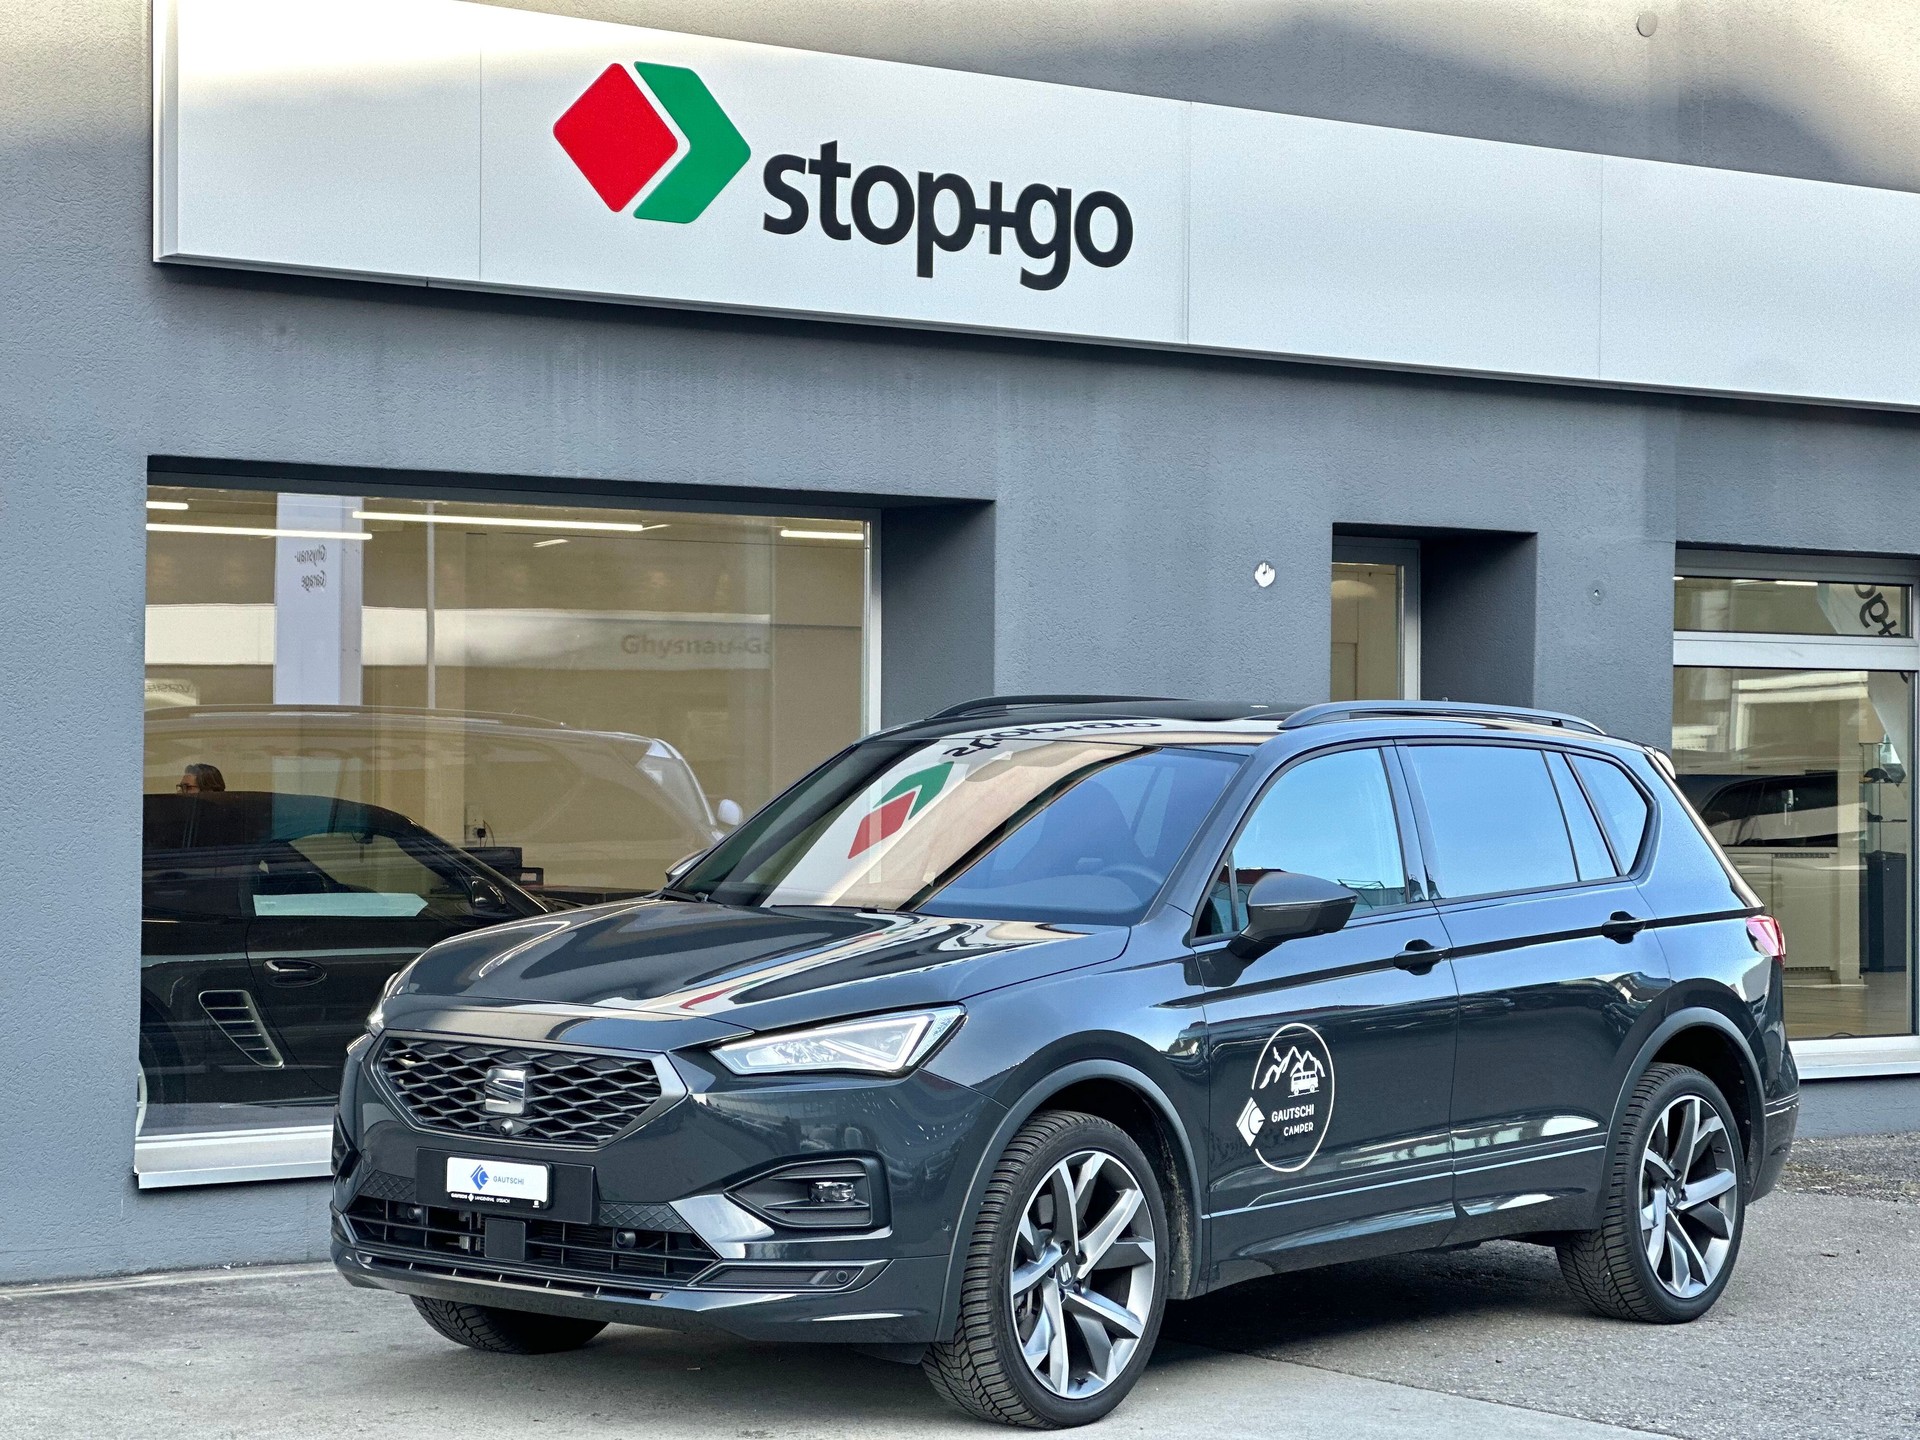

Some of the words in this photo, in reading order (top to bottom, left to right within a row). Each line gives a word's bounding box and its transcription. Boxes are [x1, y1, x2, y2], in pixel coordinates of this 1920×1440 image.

[763, 140, 1133, 291] stop+go
[1271, 1104, 1315, 1122] GAUTSCHI
[1283, 1122, 1314, 1136] CAMPER
[493, 1176, 524, 1185] GAUTSCHI
